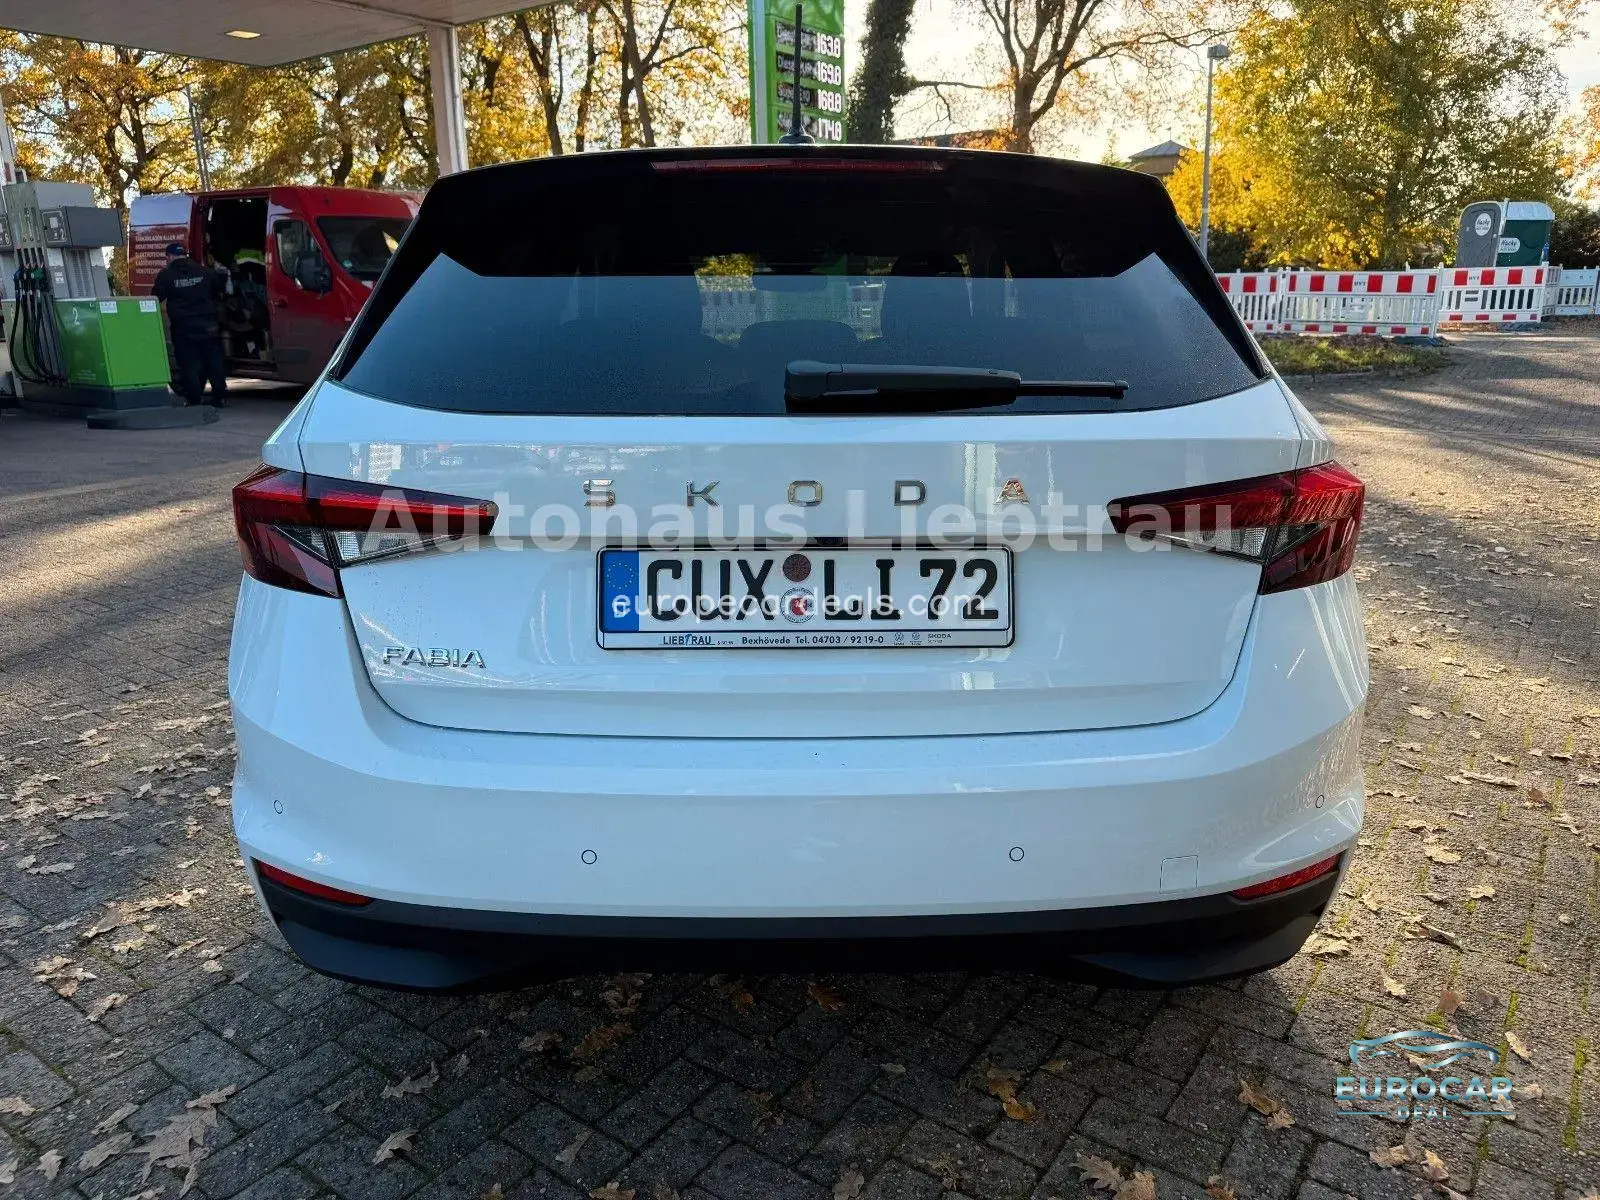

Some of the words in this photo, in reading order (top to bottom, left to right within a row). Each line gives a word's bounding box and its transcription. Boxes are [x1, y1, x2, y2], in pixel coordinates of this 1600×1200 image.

[647, 559, 775, 621] CUX
[824, 559, 901, 620] LI
[920, 558, 999, 620] 72
[742, 635, 791, 645] Bexhövede
[795, 635, 810, 644] Tel.
[812, 635, 841, 644] 04703
[382, 645, 487, 669] FABIA
